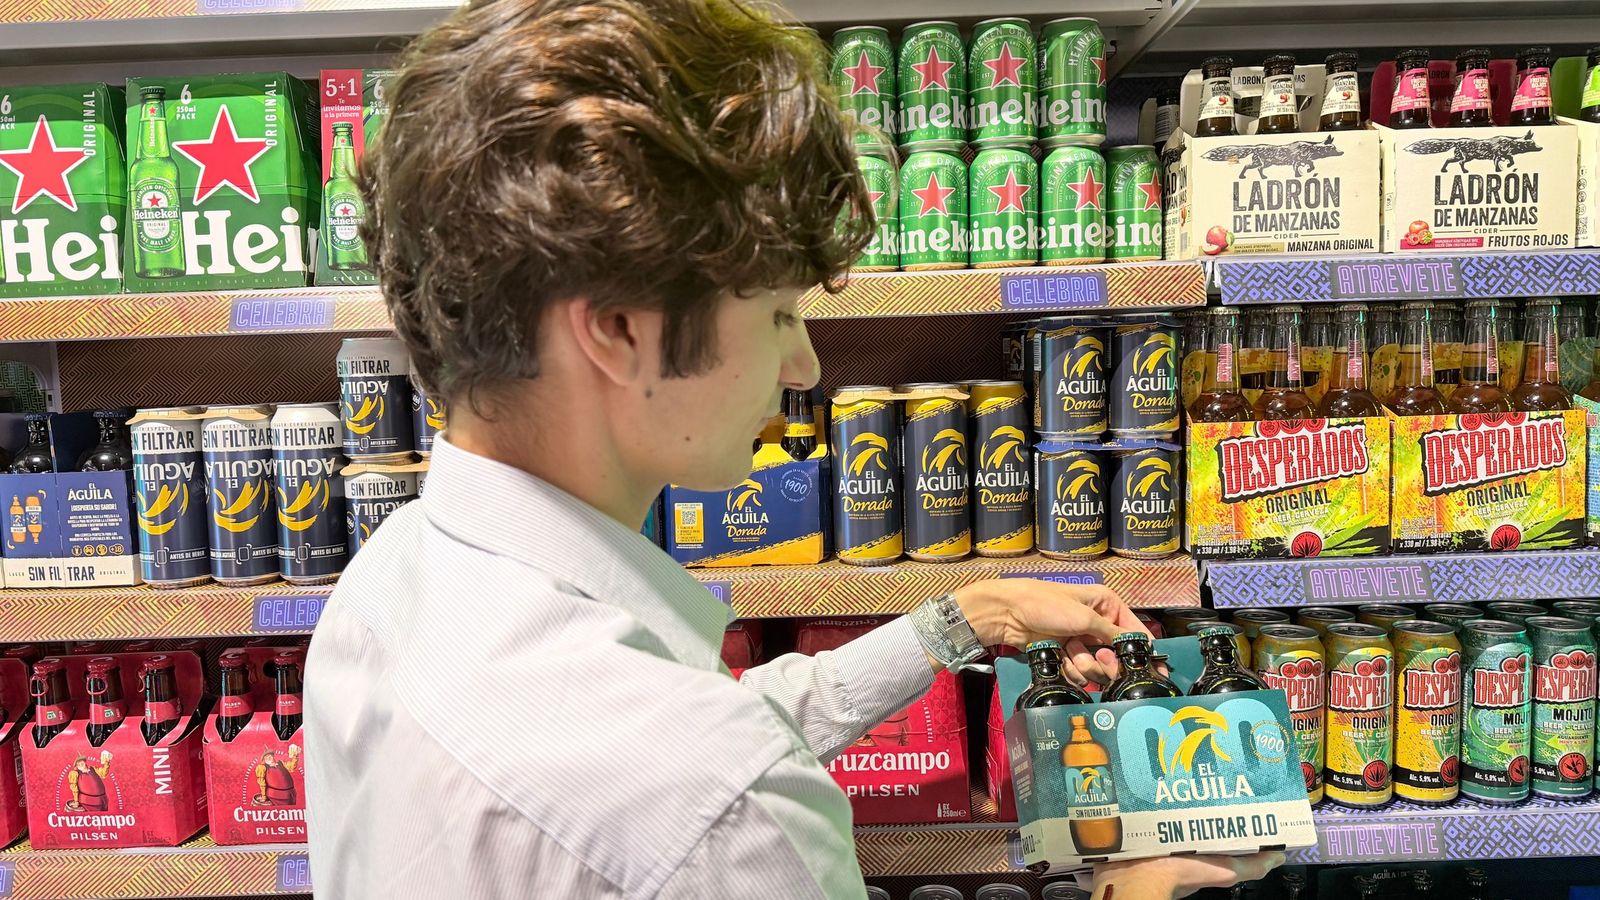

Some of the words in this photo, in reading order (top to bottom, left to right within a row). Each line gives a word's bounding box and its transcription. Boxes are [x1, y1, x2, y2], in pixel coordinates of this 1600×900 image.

[180, 84, 192, 104] 6
[0, 95, 12, 115] 6
[265, 80, 277, 146] ORIGINAL
[323, 104, 361, 112] invitamos
[83, 91, 97, 156] ORIGINAL
[1233, 173, 1340, 212] LADRÓN
[1434, 168, 1539, 205] LADRÓN
[134, 208, 179, 221] Heineken
[1233, 214, 1252, 233] DE
[1255, 210, 1340, 232] MANZANAS
[1434, 208, 1452, 227] DE
[1456, 206, 1538, 227] MANZANAS
[1274, 232, 1299, 240] CIDER
[1488, 235, 1530, 247] FRUTOS
[1533, 234, 1569, 246] ROJOS
[1287, 240, 1332, 252] MANZANA
[1334, 238, 1374, 251] ORIGINAL
[1338, 262, 1457, 295] ATREVETE
[1007, 276, 1100, 305] CELEBRA
[235, 300, 327, 327] CELEBRA
[351, 360, 390, 374] FILTRAR
[1086, 371, 1095, 380] EL
[1157, 368, 1167, 377] EL
[142, 430, 195, 451] FILTRAR
[203, 430, 218, 448] SIN
[223, 428, 273, 448] FILTRAR
[284, 426, 335, 446] FILTRAR
[1222, 428, 1367, 495] DESPERADOS
[1425, 421, 1565, 488] DESPERADOS
[865, 471, 876, 479] EL
[947, 467, 956, 475] EL
[1004, 463, 1014, 472] EL
[225, 478, 239, 489] EL
[288, 478, 298, 487] EL
[838, 475, 895, 495] ÁGUILA
[974, 468, 1030, 487] ÁGUILA
[67, 488, 113, 501] ÁGUILA
[145, 482, 156, 491] EL
[351, 482, 365, 496] SIN
[368, 480, 407, 496] FILTRAR
[785, 478, 808, 495] 1900
[1466, 482, 1531, 507] ORIGINAL
[842, 495, 893, 513] Dorada
[921, 492, 968, 509] Dorada
[978, 487, 1029, 504] Dorada
[1080, 494, 1090, 502] EL
[1150, 492, 1160, 500] EL
[1266, 488, 1332, 515] ORIGINAL
[1050, 500, 1105, 516] ÁGUILA
[1120, 497, 1176, 514] ÁGUILA
[722, 512, 769, 525] ÁGUILA
[1054, 516, 1103, 533] Dorada
[1124, 515, 1174, 530] Dorada
[726, 524, 767, 537] Dorada
[29, 566, 46, 581] SIN
[49, 566, 62, 581] FIL
[67, 566, 95, 582] TRAR
[1309, 566, 1426, 598] ATREVETE
[259, 599, 327, 627] CELEB
[1533, 664, 1596, 701] ESPERA
[1553, 708, 1593, 722] MOJITO
[1543, 721, 1563, 729] BEER
[1342, 730, 1364, 738] BEER
[1255, 734, 1285, 753] 1900
[152, 747, 173, 795] MINI
[824, 751, 950, 775] ruzcampo
[1198, 761, 1216, 776] EL
[847, 783, 920, 798] PILSEN
[1154, 774, 1256, 804] ÁGUILA
[47, 811, 135, 829] Cruzcampo
[1076, 809, 1084, 818] SIN
[1084, 808, 1103, 818] FILTRAR
[70, 832, 118, 841] PILSEN
[255, 826, 305, 836] PILSEN
[1157, 820, 1185, 844] SIN
[1188, 816, 1248, 842] FILTRAR
[1251, 813, 1278, 837] 0.0
[1326, 823, 1440, 856] ATREVETE
